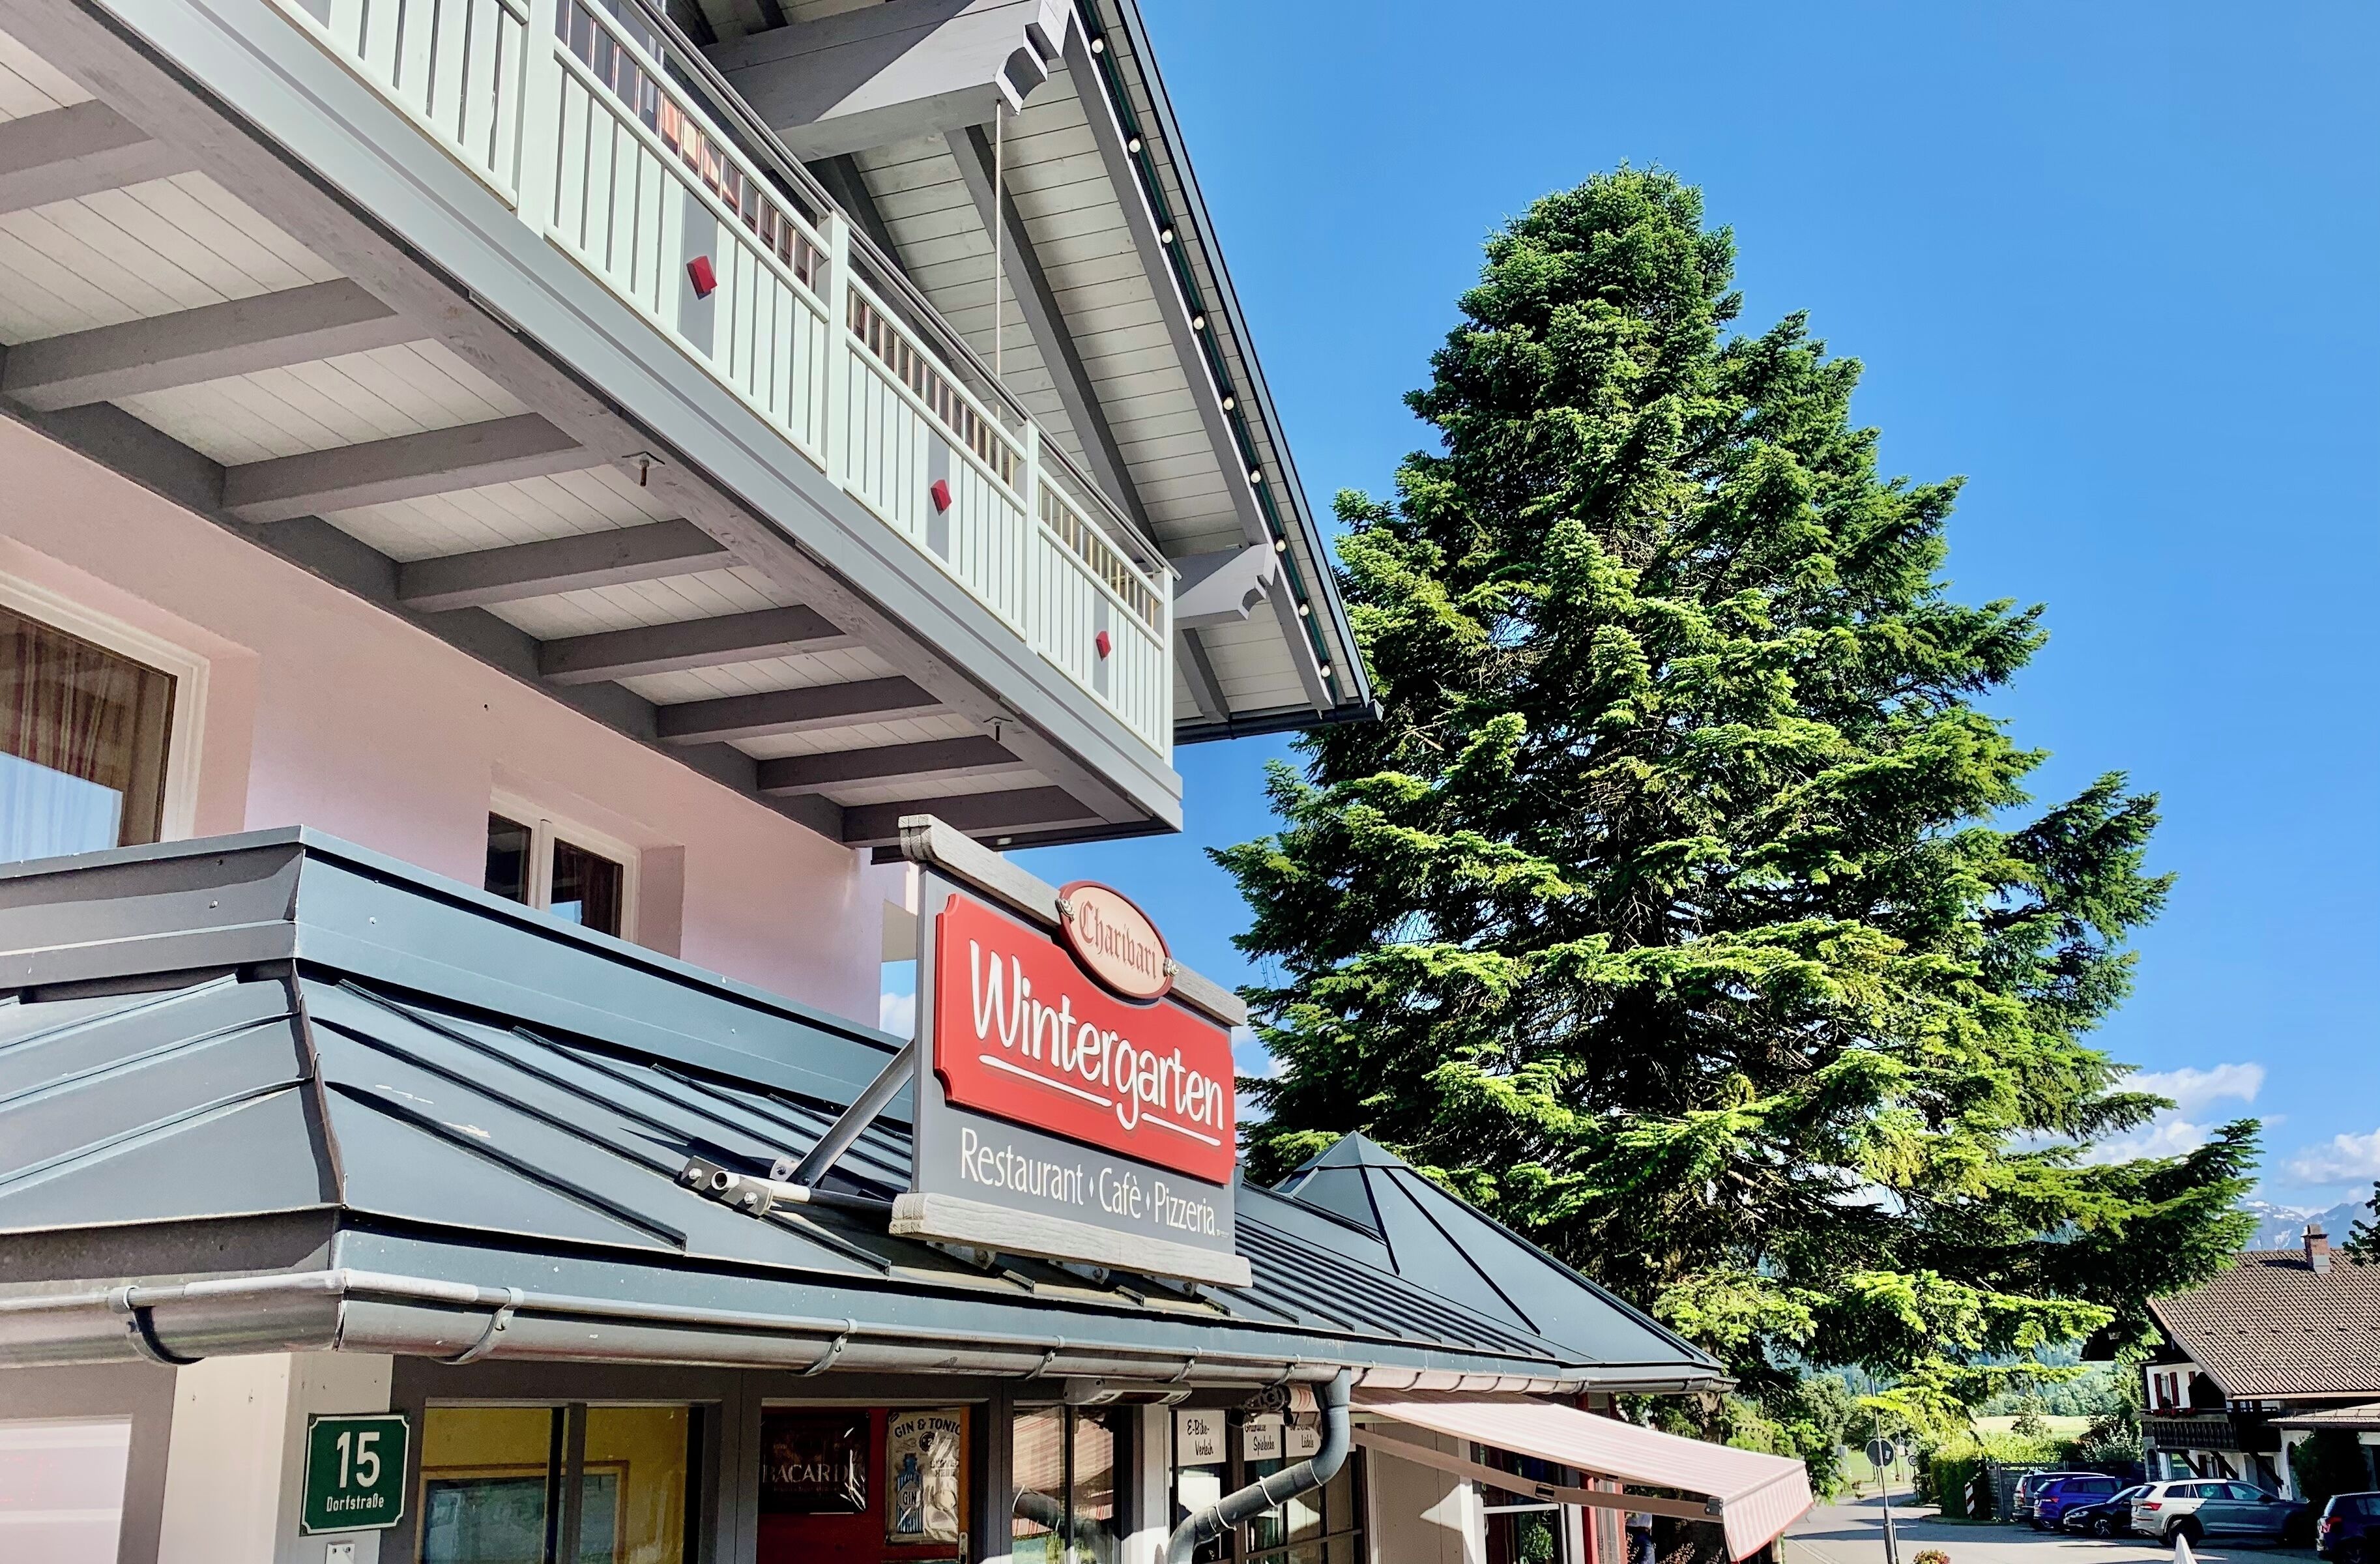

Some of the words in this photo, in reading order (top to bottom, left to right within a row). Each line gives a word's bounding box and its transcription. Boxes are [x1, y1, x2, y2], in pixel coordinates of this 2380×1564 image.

[1079, 901, 1158, 980] Charivari
[968, 938, 1225, 1131] Wintergarten
[961, 1127, 1084, 1206] Restaurant
[894, 1420, 914, 1439] GIN
[917, 1419, 927, 1431] &
[1187, 1418, 1210, 1436] E-Bike-
[1195, 1438, 1213, 1456] Verleih
[336, 1431, 381, 1489] 15
[325, 1492, 385, 1514] Dorfstraße
[903, 1491, 917, 1505] GIN
